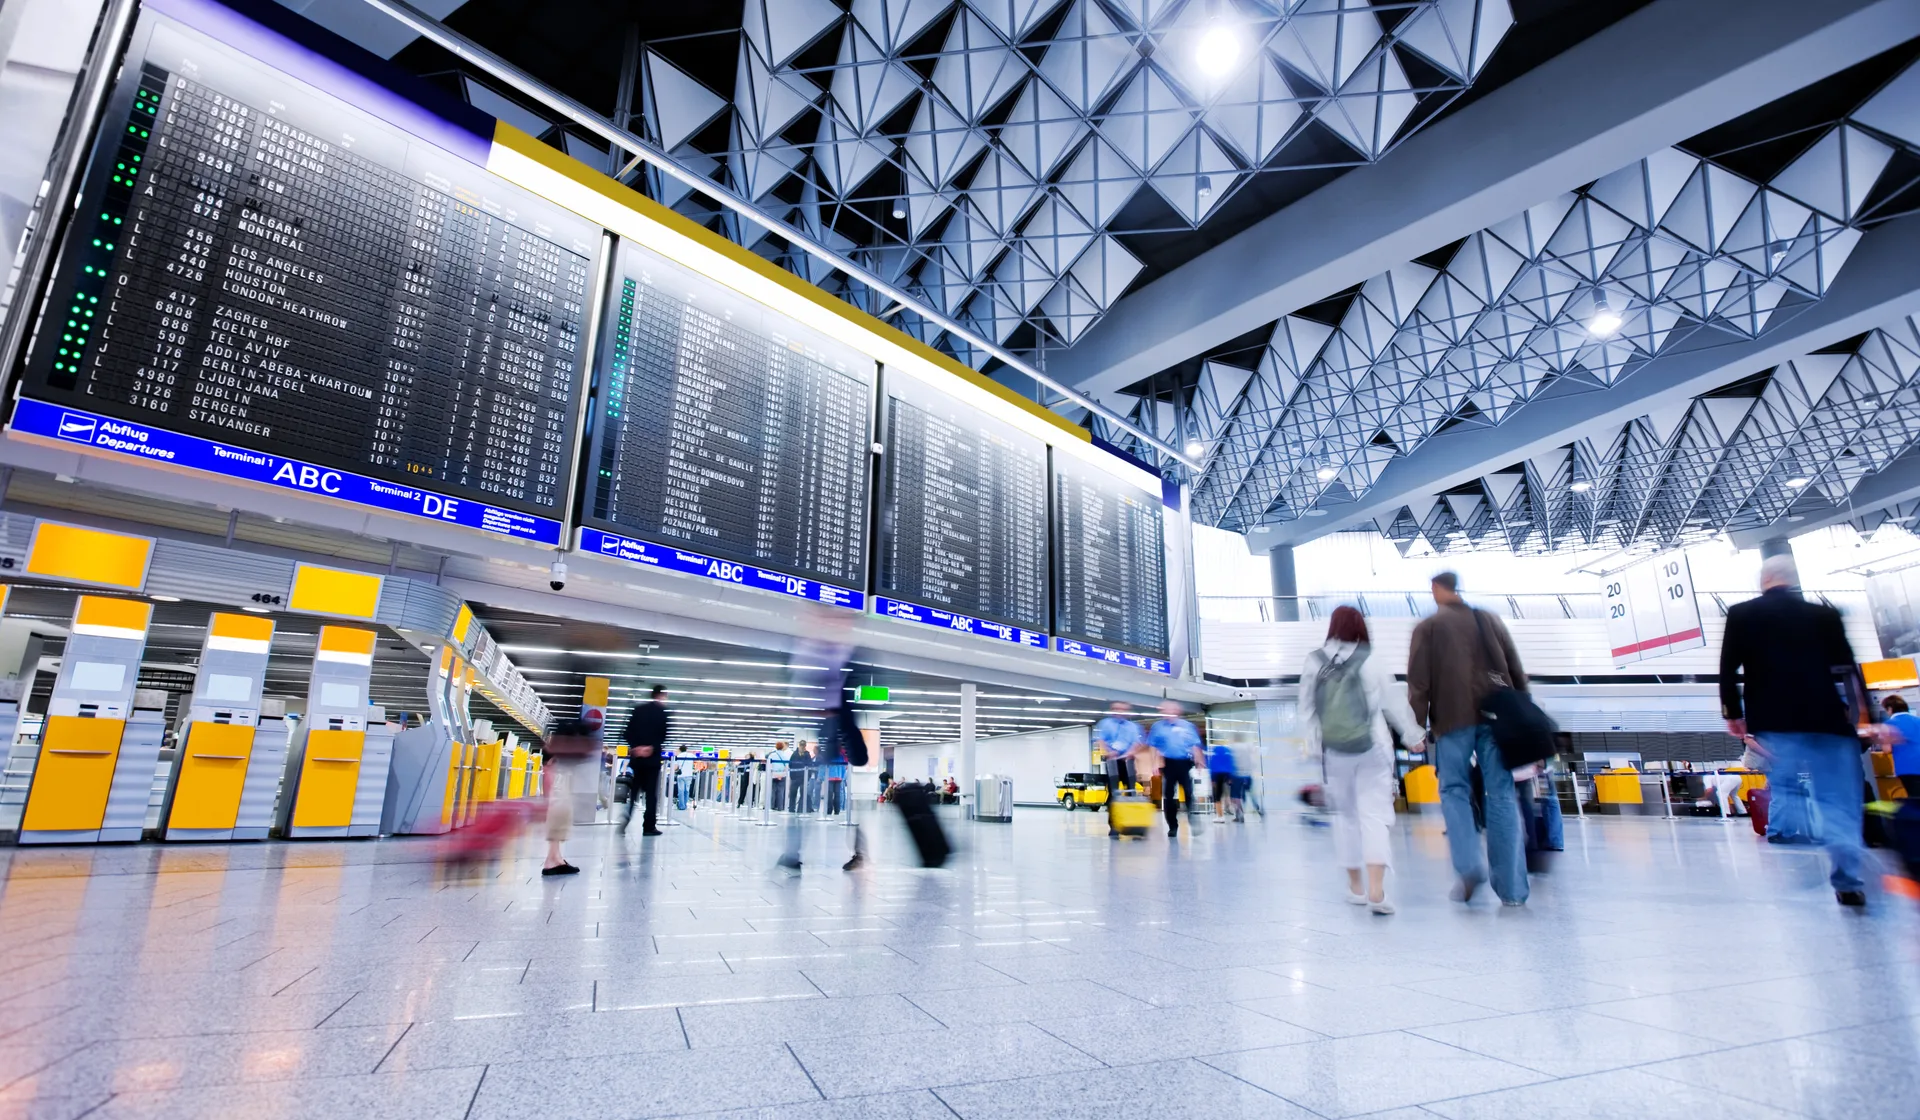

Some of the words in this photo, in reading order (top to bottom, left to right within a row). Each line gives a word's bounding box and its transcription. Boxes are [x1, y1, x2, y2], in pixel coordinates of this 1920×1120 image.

[210, 106, 245, 128] 3102
[262, 128, 324, 162] HELSINKI
[213, 95, 248, 117] 2188
[264, 118, 329, 153] VARADERO
[212, 132, 239, 151] 462
[256, 150, 296, 174] MIAMI
[215, 121, 242, 139] 468
[259, 139, 324, 174] PORTLAND
[197, 152, 233, 173] 3236
[196, 191, 224, 209] 494
[241, 208, 300, 238] CALGARY
[192, 203, 220, 221] 875
[238, 219, 306, 252] MONTREAL
[182, 239, 211, 257] 442
[228, 255, 289, 284] DETROIT
[185, 227, 214, 245] 456
[231, 243, 259, 261] LOS
[266, 255, 324, 284] ANGELES
[178, 252, 207, 270] 440
[225, 268, 286, 296] HOUSTON
[165, 261, 204, 282] 4726
[222, 280, 347, 329] LONDON-HEATHROW
[167, 290, 197, 308] 417
[215, 305, 269, 330] ZAGREB
[154, 300, 194, 321] 6808
[212, 317, 258, 340] KOELN
[265, 333, 292, 350] HBF
[685, 314, 719, 335] SALVADOR
[160, 316, 190, 333] 686
[209, 330, 237, 347] TEL
[245, 341, 280, 360] AVIV
[714, 335, 734, 350] AIRES
[156, 329, 187, 346] 590
[205, 343, 252, 365] ADDIS
[259, 358, 373, 399] ABEBA-KHARTOUM
[680, 358, 706, 374] BILBAO
[681, 349, 703, 364] SOFIA
[149, 355, 180, 373] 117
[198, 369, 280, 399] LJUBLJANA
[153, 342, 183, 360] 176
[202, 356, 308, 394] BERLIN-TEGEL
[679, 366, 726, 391] DUESSELDORF
[135, 366, 176, 386] 4980
[195, 382, 251, 405] DUBLIN
[677, 384, 712, 404] BUDAPEST
[131, 379, 173, 399] 3126
[191, 395, 248, 418] BERGEN
[676, 393, 689, 405] NEW
[694, 400, 711, 413] YORK
[127, 393, 169, 413] 3160
[188, 408, 271, 437] STAVANGER
[675, 403, 706, 420] KOLKATA
[100, 422, 149, 442] Abflug
[673, 421, 704, 438] CHICAGO
[674, 412, 701, 427] DALLAS
[706, 423, 723, 435] FORT
[727, 430, 748, 443] WORTH
[97, 434, 175, 460] Departures
[672, 430, 704, 447] DETROIT
[670, 449, 684, 460] ROM
[671, 439, 694, 453] PARIS
[716, 454, 725, 463] DE
[729, 458, 754, 473] GAULLE
[213, 446, 266, 466] Terminal
[268, 459, 274, 468] 1
[273, 462, 342, 494] ABC
[370, 482, 412, 499] Terminal
[414, 492, 421, 501] 2
[423, 495, 458, 520] DE
[668, 468, 709, 487] NUERNBERG
[669, 458, 744, 488] MOSKAU-DOMODEDOVO
[666, 487, 698, 503] TORONTO
[667, 477, 699, 493] VILNIUS
[664, 506, 706, 524] AMSTERDAM
[665, 496, 701, 513] HELSINKI
[662, 526, 690, 540] DUBLIN
[663, 516, 718, 537] POZNAN/POSEN
[620, 549, 658, 564] Departures
[621, 540, 645, 552] Abflug
[0, 557, 14, 568] 5
[1663, 561, 1679, 578] 10
[676, 552, 703, 565] Terminal
[707, 560, 743, 582] ABC
[757, 570, 781, 582] Terminal
[786, 578, 807, 596] DE
[251, 593, 281, 606] 464
[1607, 582, 1621, 598] 20
[1668, 584, 1684, 600] 10
[1610, 604, 1625, 619] 20
[951, 616, 973, 631] ABC
[999, 626, 1012, 640] DE
[1105, 650, 1120, 662] ABC
[1137, 657, 1146, 668] DE
